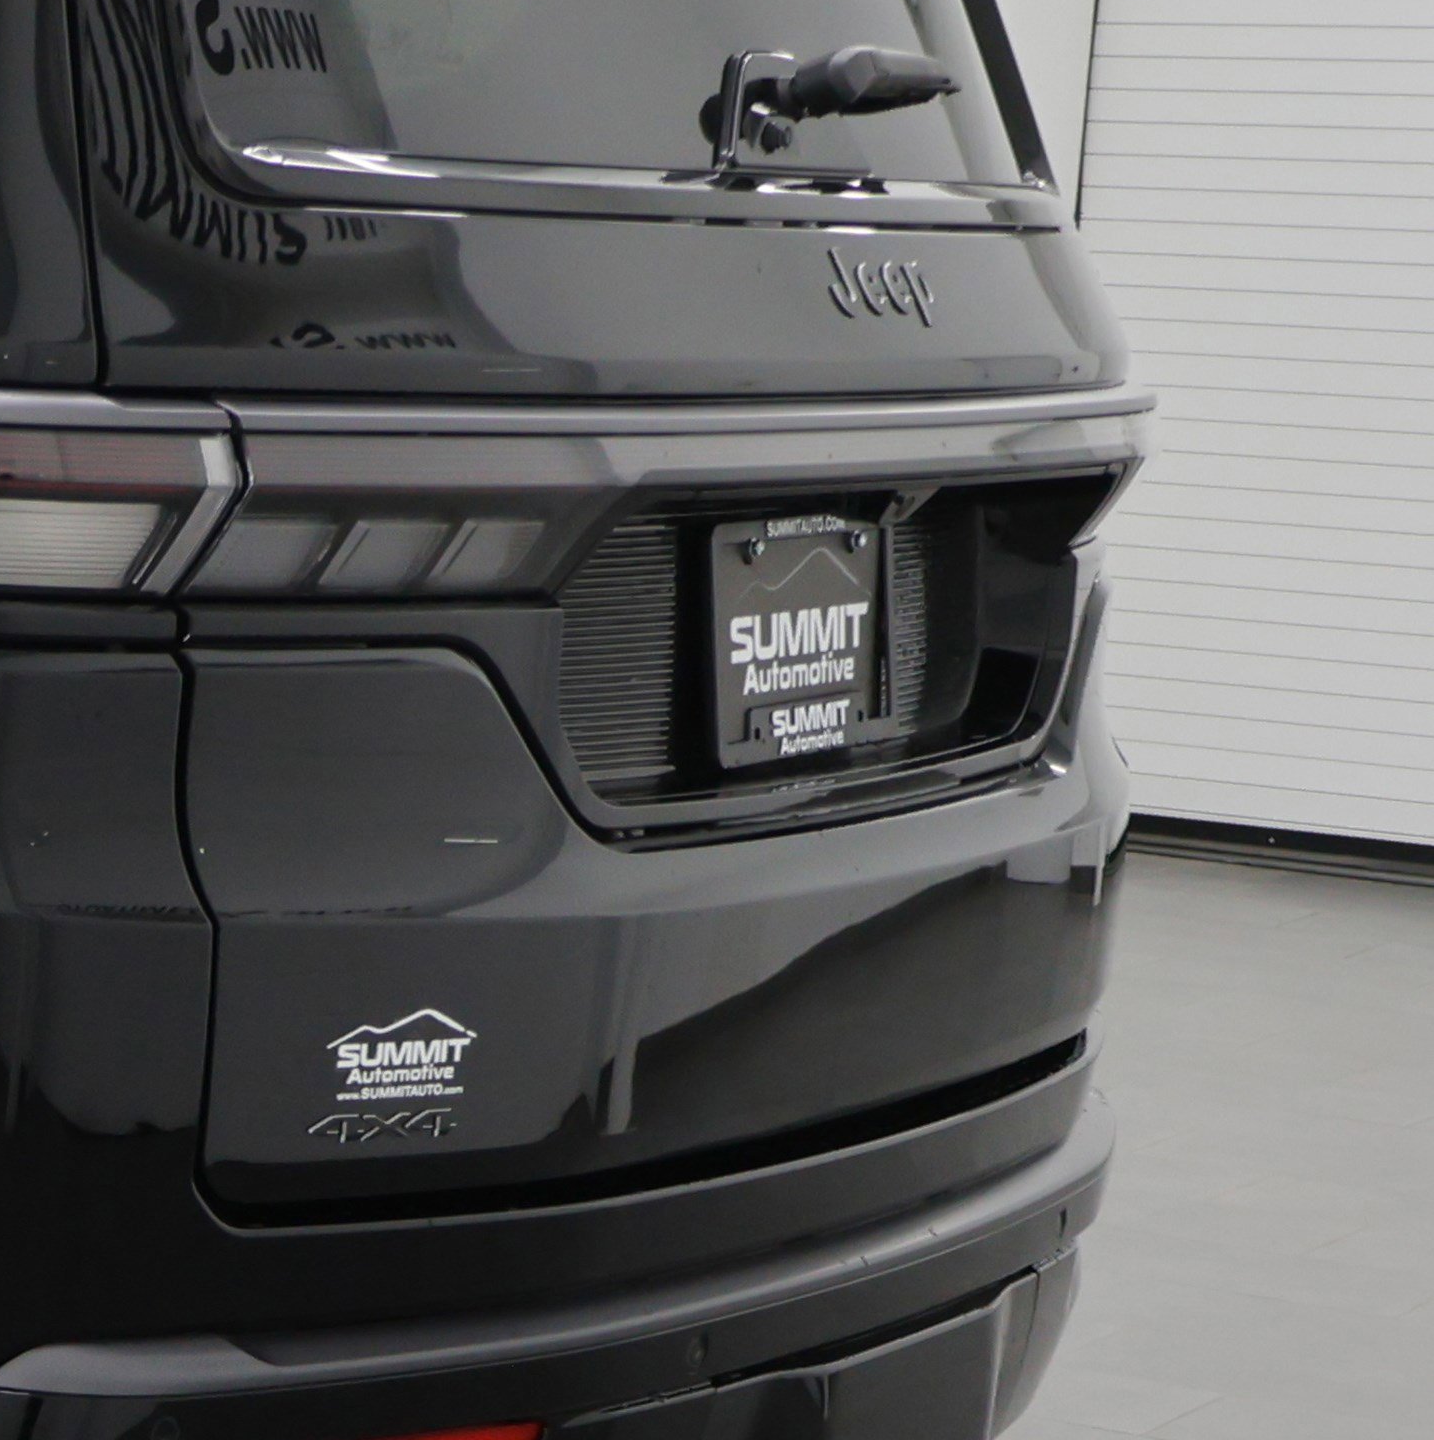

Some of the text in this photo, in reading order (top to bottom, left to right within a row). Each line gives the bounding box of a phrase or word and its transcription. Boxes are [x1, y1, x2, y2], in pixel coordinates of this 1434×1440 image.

[827, 246, 935, 328] Jeep
[730, 601, 869, 664] SUMMIT
[743, 652, 854, 696] Automotive
[771, 699, 851, 738] SUMMIT
[780, 728, 845, 756] Automotive
[336, 1037, 471, 1069] SUMMIT
[346, 1063, 455, 1085] Automotive
[336, 1083, 464, 1101] www.SUMMITAUTO.com
